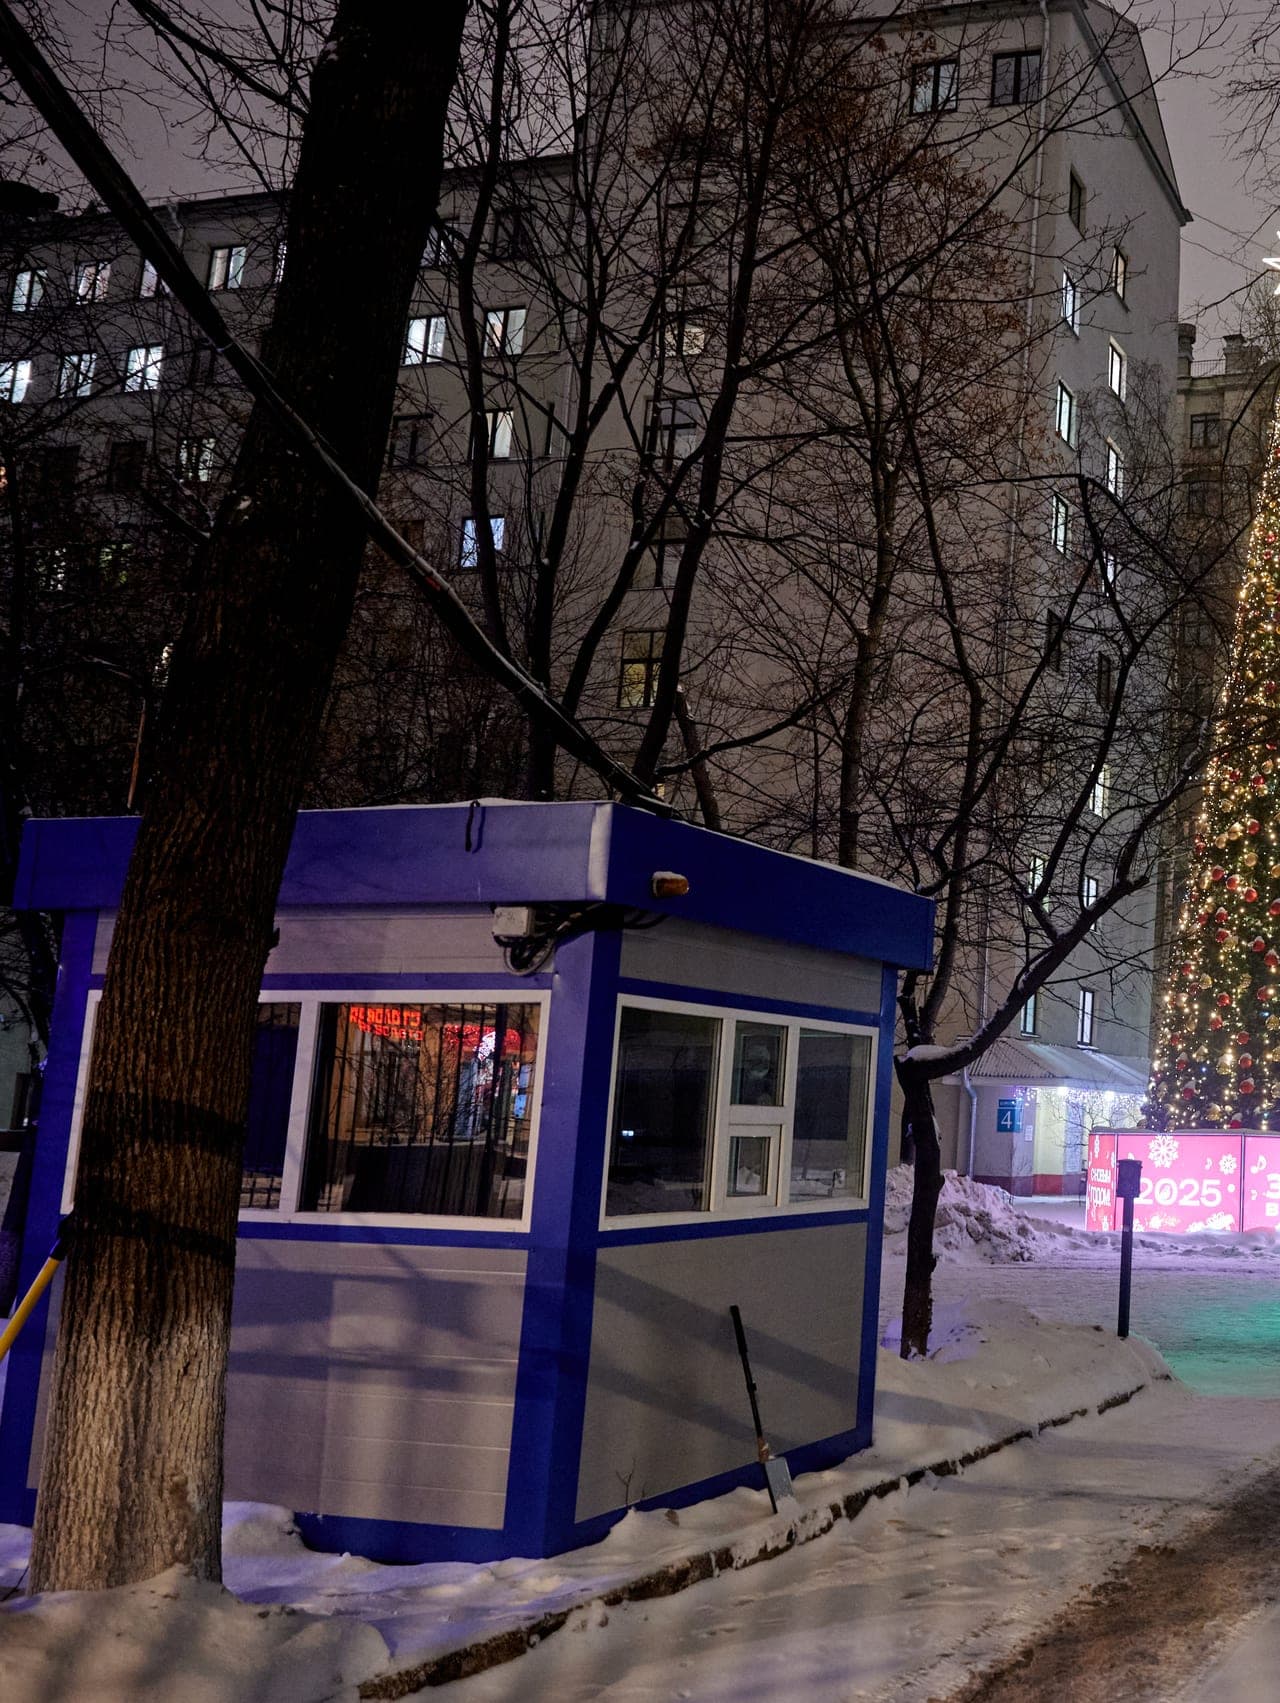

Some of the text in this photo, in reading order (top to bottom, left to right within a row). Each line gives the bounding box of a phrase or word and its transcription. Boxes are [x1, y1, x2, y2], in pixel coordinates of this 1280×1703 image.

[1000, 1110, 1013, 1129] 4
[1134, 1178, 1222, 1208] 2025
[1265, 1203, 1279, 1217] В
